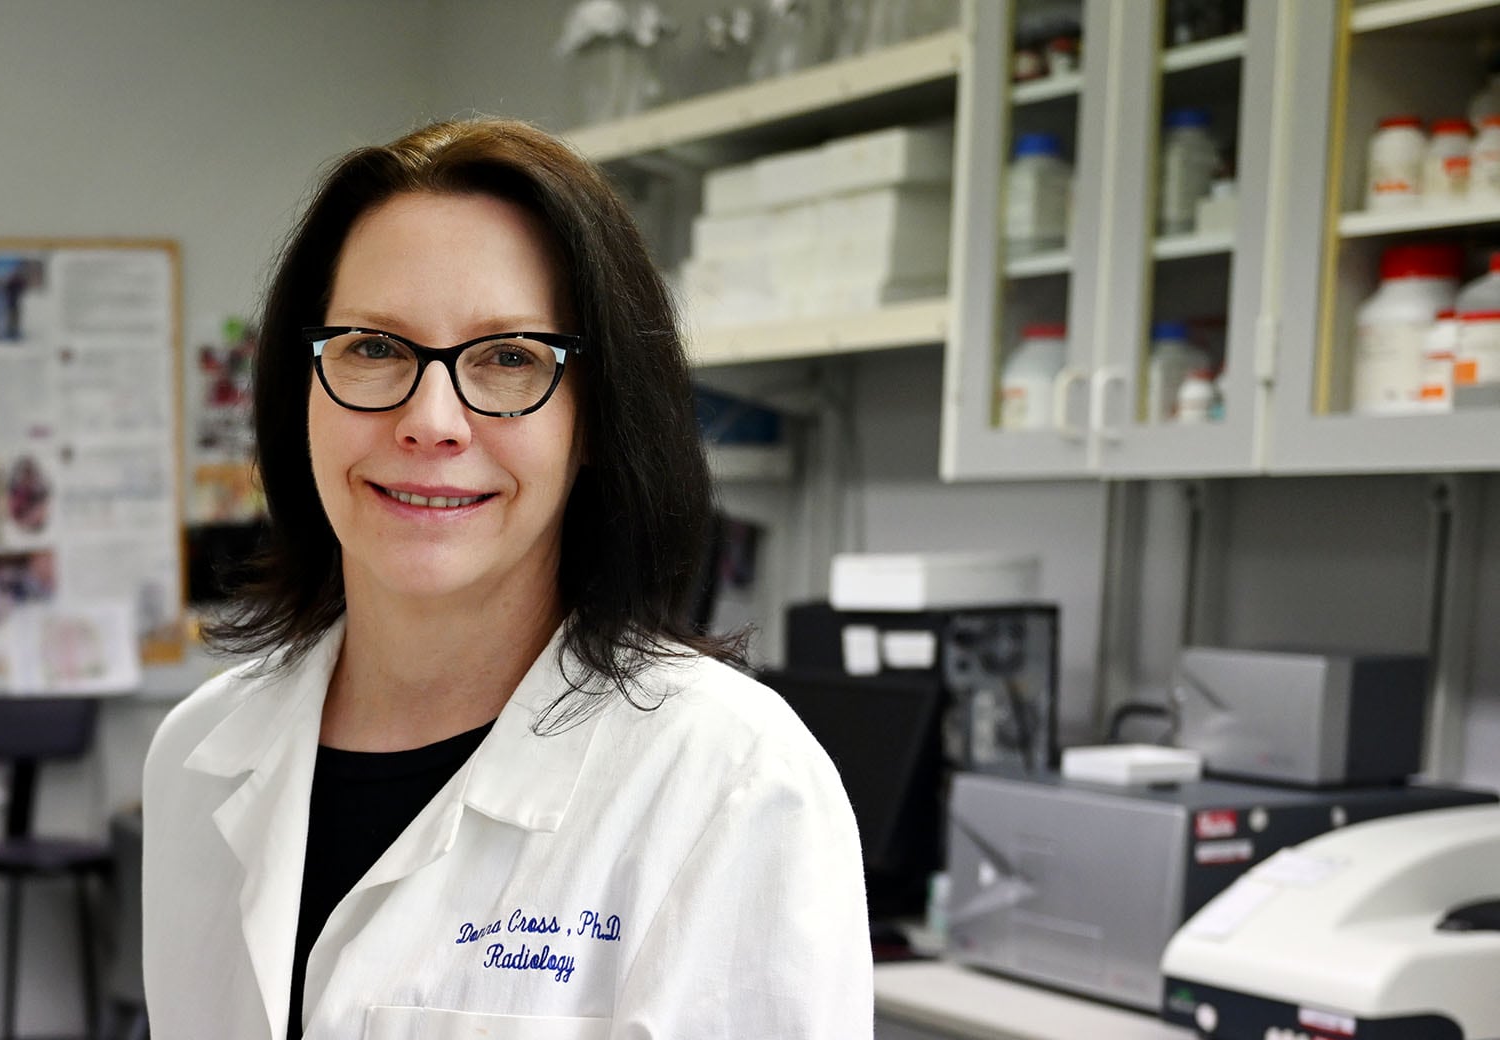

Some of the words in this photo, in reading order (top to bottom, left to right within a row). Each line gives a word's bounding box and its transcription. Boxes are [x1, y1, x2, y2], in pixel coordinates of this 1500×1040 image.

[455, 919, 502, 944] Donna
[507, 908, 561, 934] Cross
[577, 910, 621, 942] Ph.D.
[484, 943, 575, 983] Radiology
